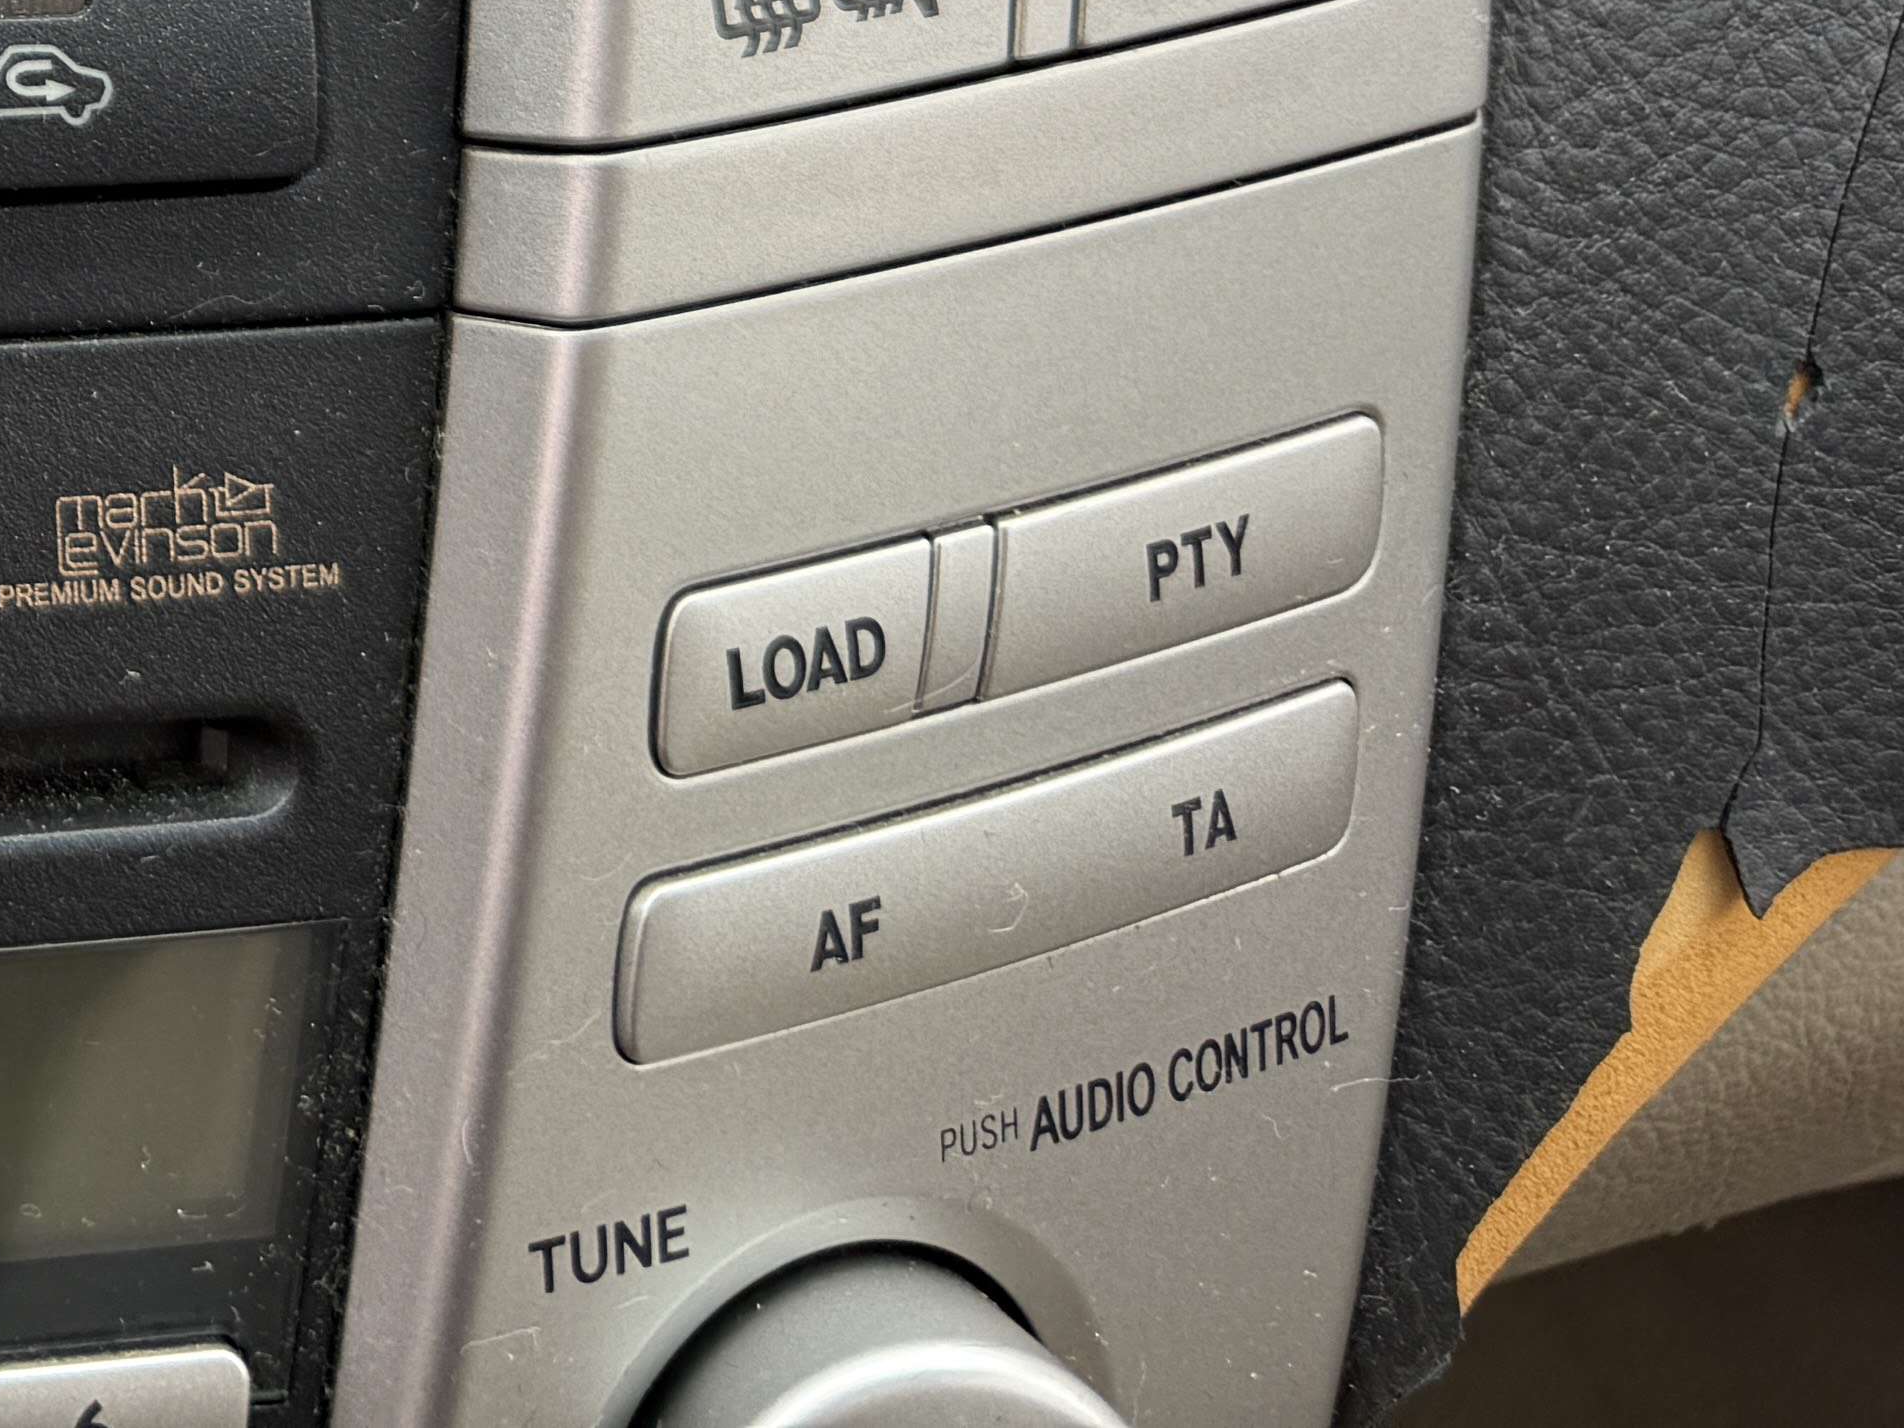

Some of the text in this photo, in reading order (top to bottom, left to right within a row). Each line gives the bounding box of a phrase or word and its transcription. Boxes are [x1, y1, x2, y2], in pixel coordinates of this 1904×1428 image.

[130, 572, 224, 602] SOUND
[234, 563, 339, 595] SYSTEM
[1143, 513, 1252, 602] PTY
[725, 615, 887, 711] LOAD
[1170, 788, 1238, 857] TA
[808, 896, 882, 972] AF
[939, 994, 1349, 1162] PUSH AUDIO CONTROL
[529, 1204, 690, 1294] TUNE
